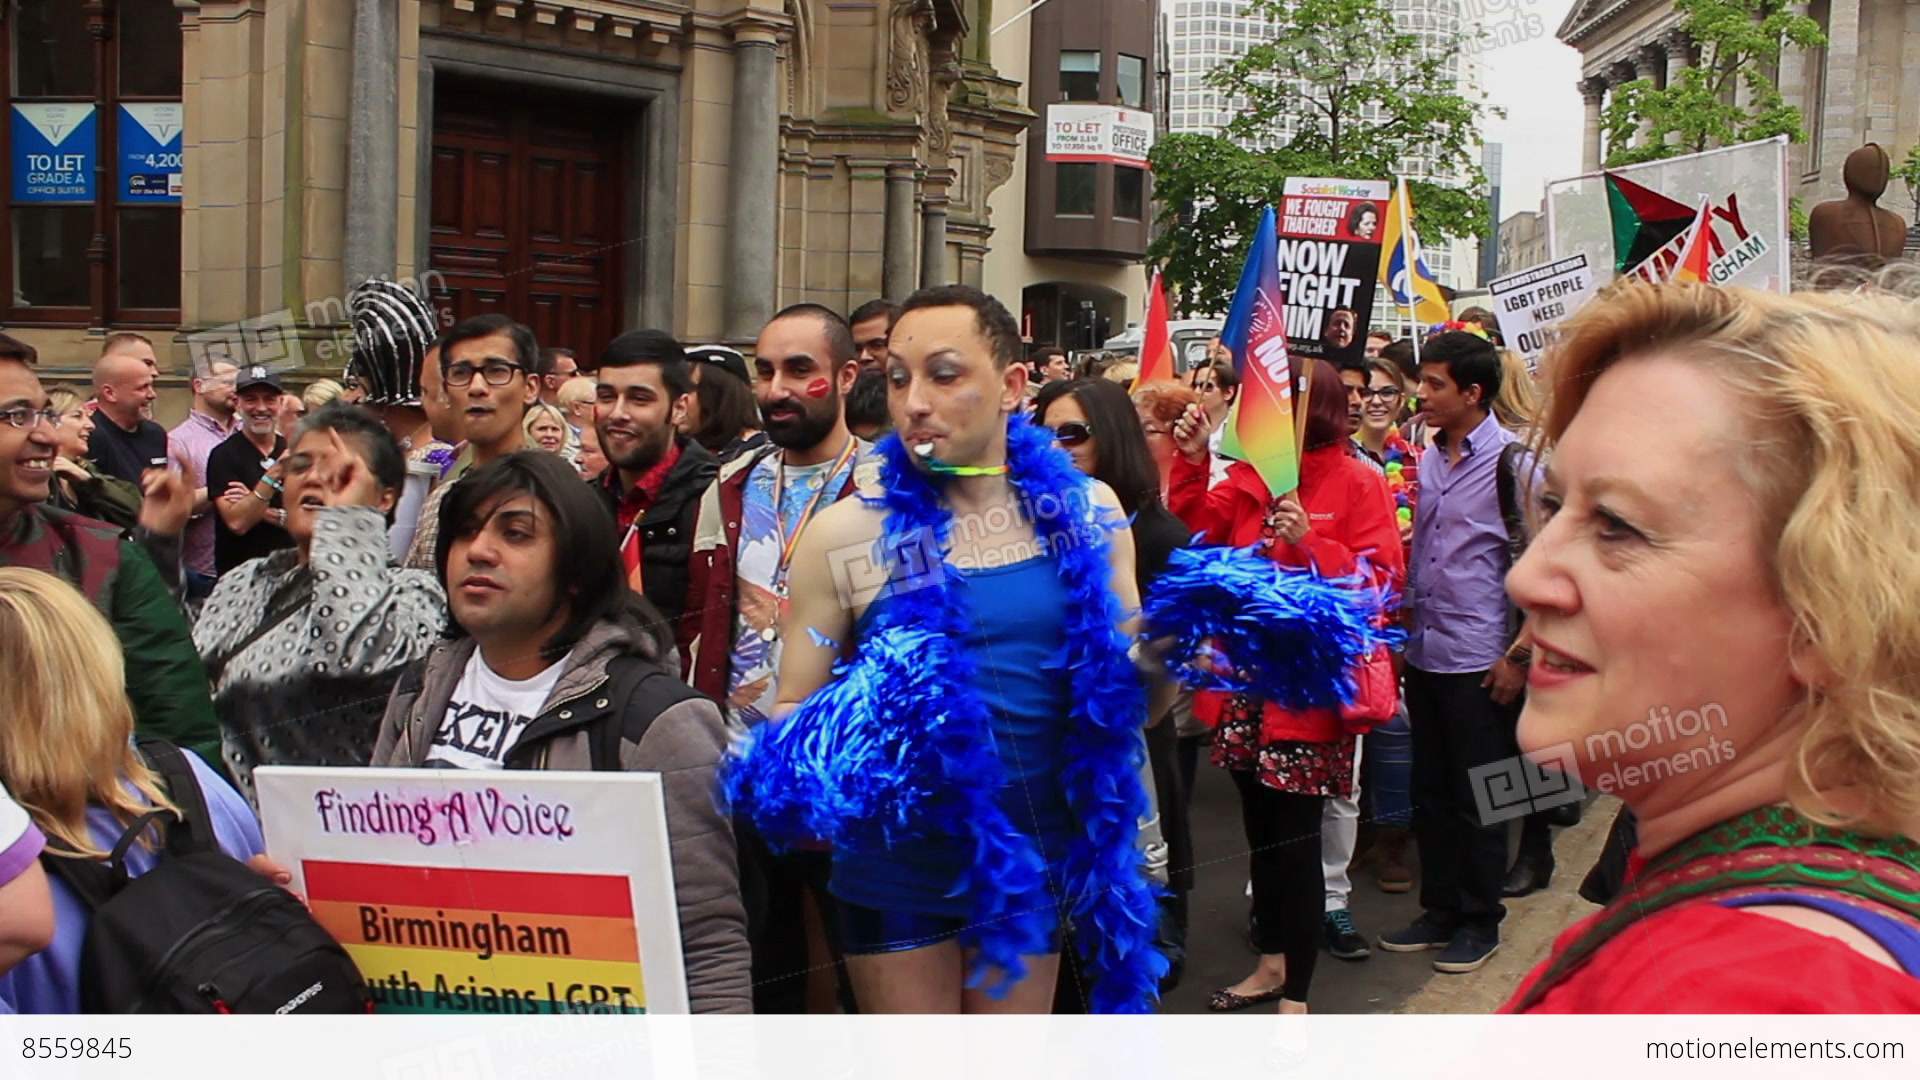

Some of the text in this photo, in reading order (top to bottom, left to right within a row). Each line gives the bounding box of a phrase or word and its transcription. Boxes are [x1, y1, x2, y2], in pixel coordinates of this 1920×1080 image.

[1054, 122, 1101, 133] TO LET
[1112, 133, 1147, 151] OFFICE
[27, 154, 85, 171] TO LET
[27, 172, 85, 184] GRADE A
[1285, 198, 1349, 218] WE FOUGHT
[1282, 215, 1338, 236] THATCHER
[1278, 239, 1349, 276] NOW
[1503, 275, 1584, 313] LGBT PEOPLE
[1532, 302, 1565, 323] NEED
[315, 787, 575, 845] Finding A Voice
[358, 904, 571, 960] Birmingham
[434, 972, 539, 1013] Asians
